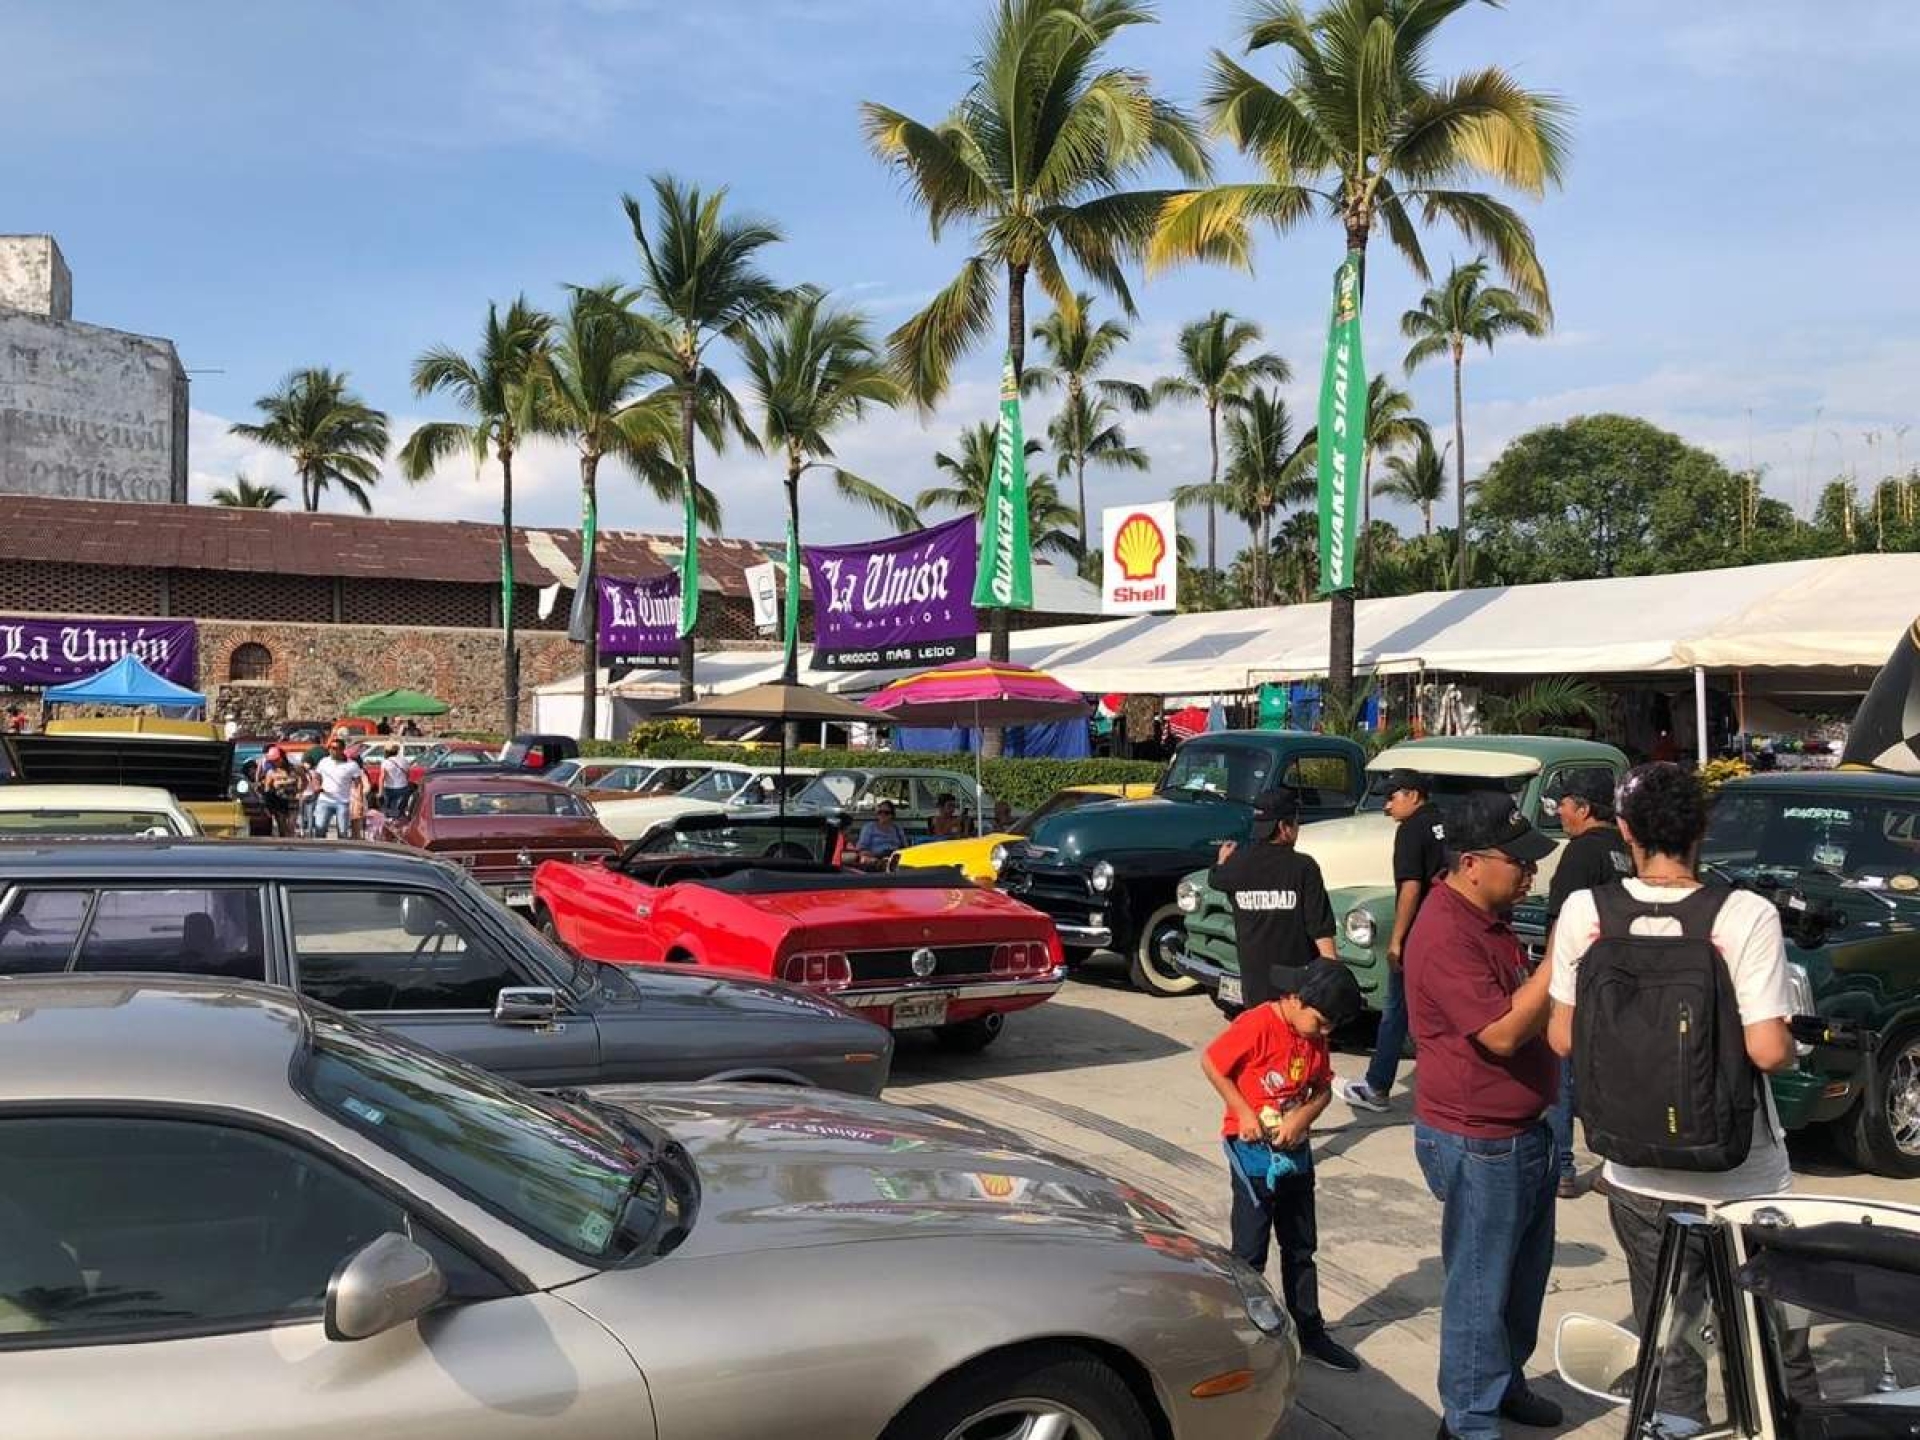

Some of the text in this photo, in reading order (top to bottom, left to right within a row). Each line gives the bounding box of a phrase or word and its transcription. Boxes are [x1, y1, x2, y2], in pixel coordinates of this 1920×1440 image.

[992, 412, 1014, 604] QUAKER STATE
[820, 544, 950, 613] La Unión
[1113, 584, 1166, 602] Shell
[606, 586, 638, 627] La
[0, 625, 169, 662] La Unión
